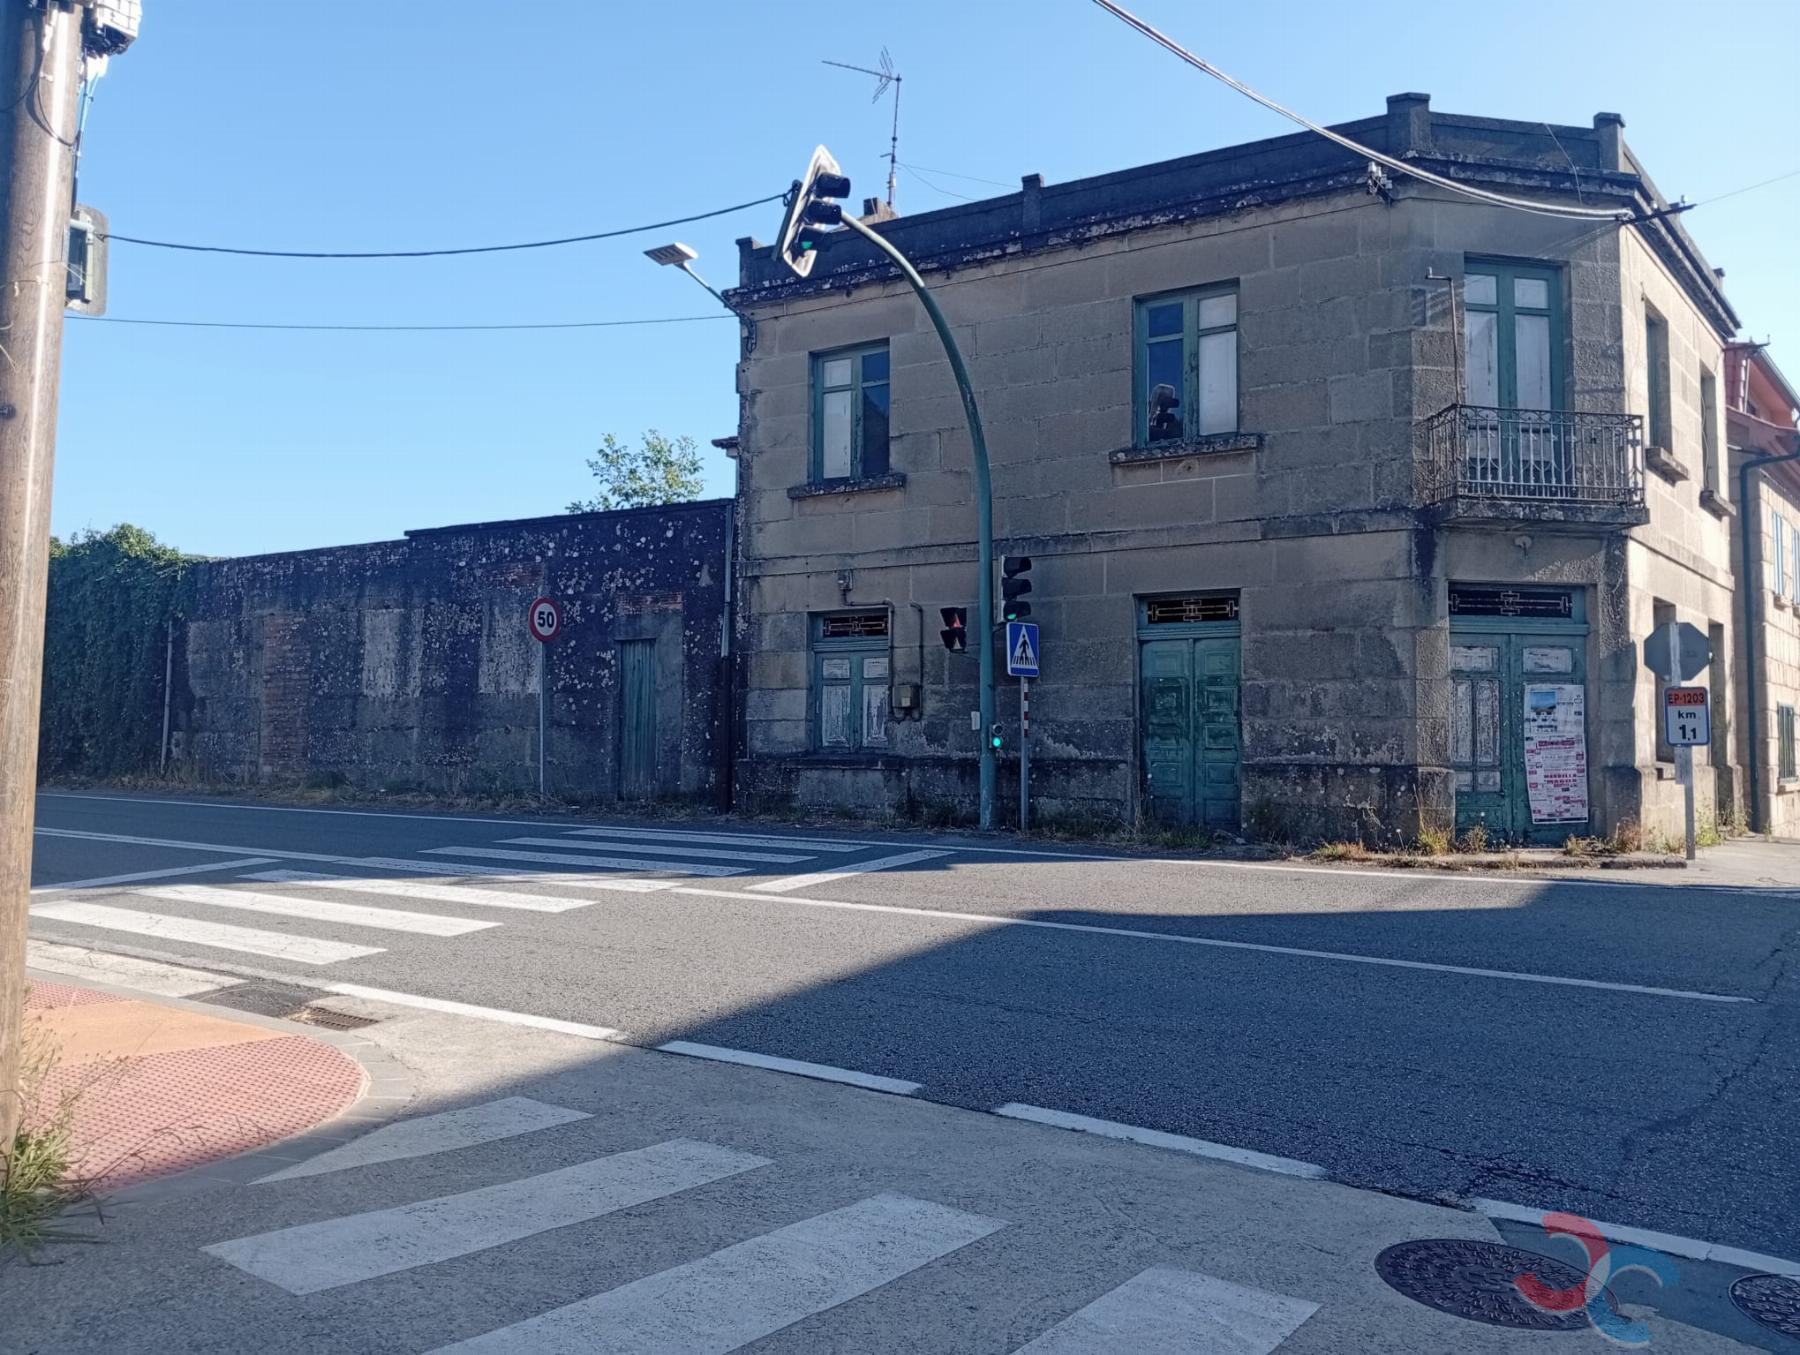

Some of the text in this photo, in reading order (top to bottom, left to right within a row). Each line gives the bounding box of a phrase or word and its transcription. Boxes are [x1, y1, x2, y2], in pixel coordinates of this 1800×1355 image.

[537, 611, 555, 628] 50
[1668, 693, 1704, 704] EP-1203
[1678, 710, 1696, 719] km
